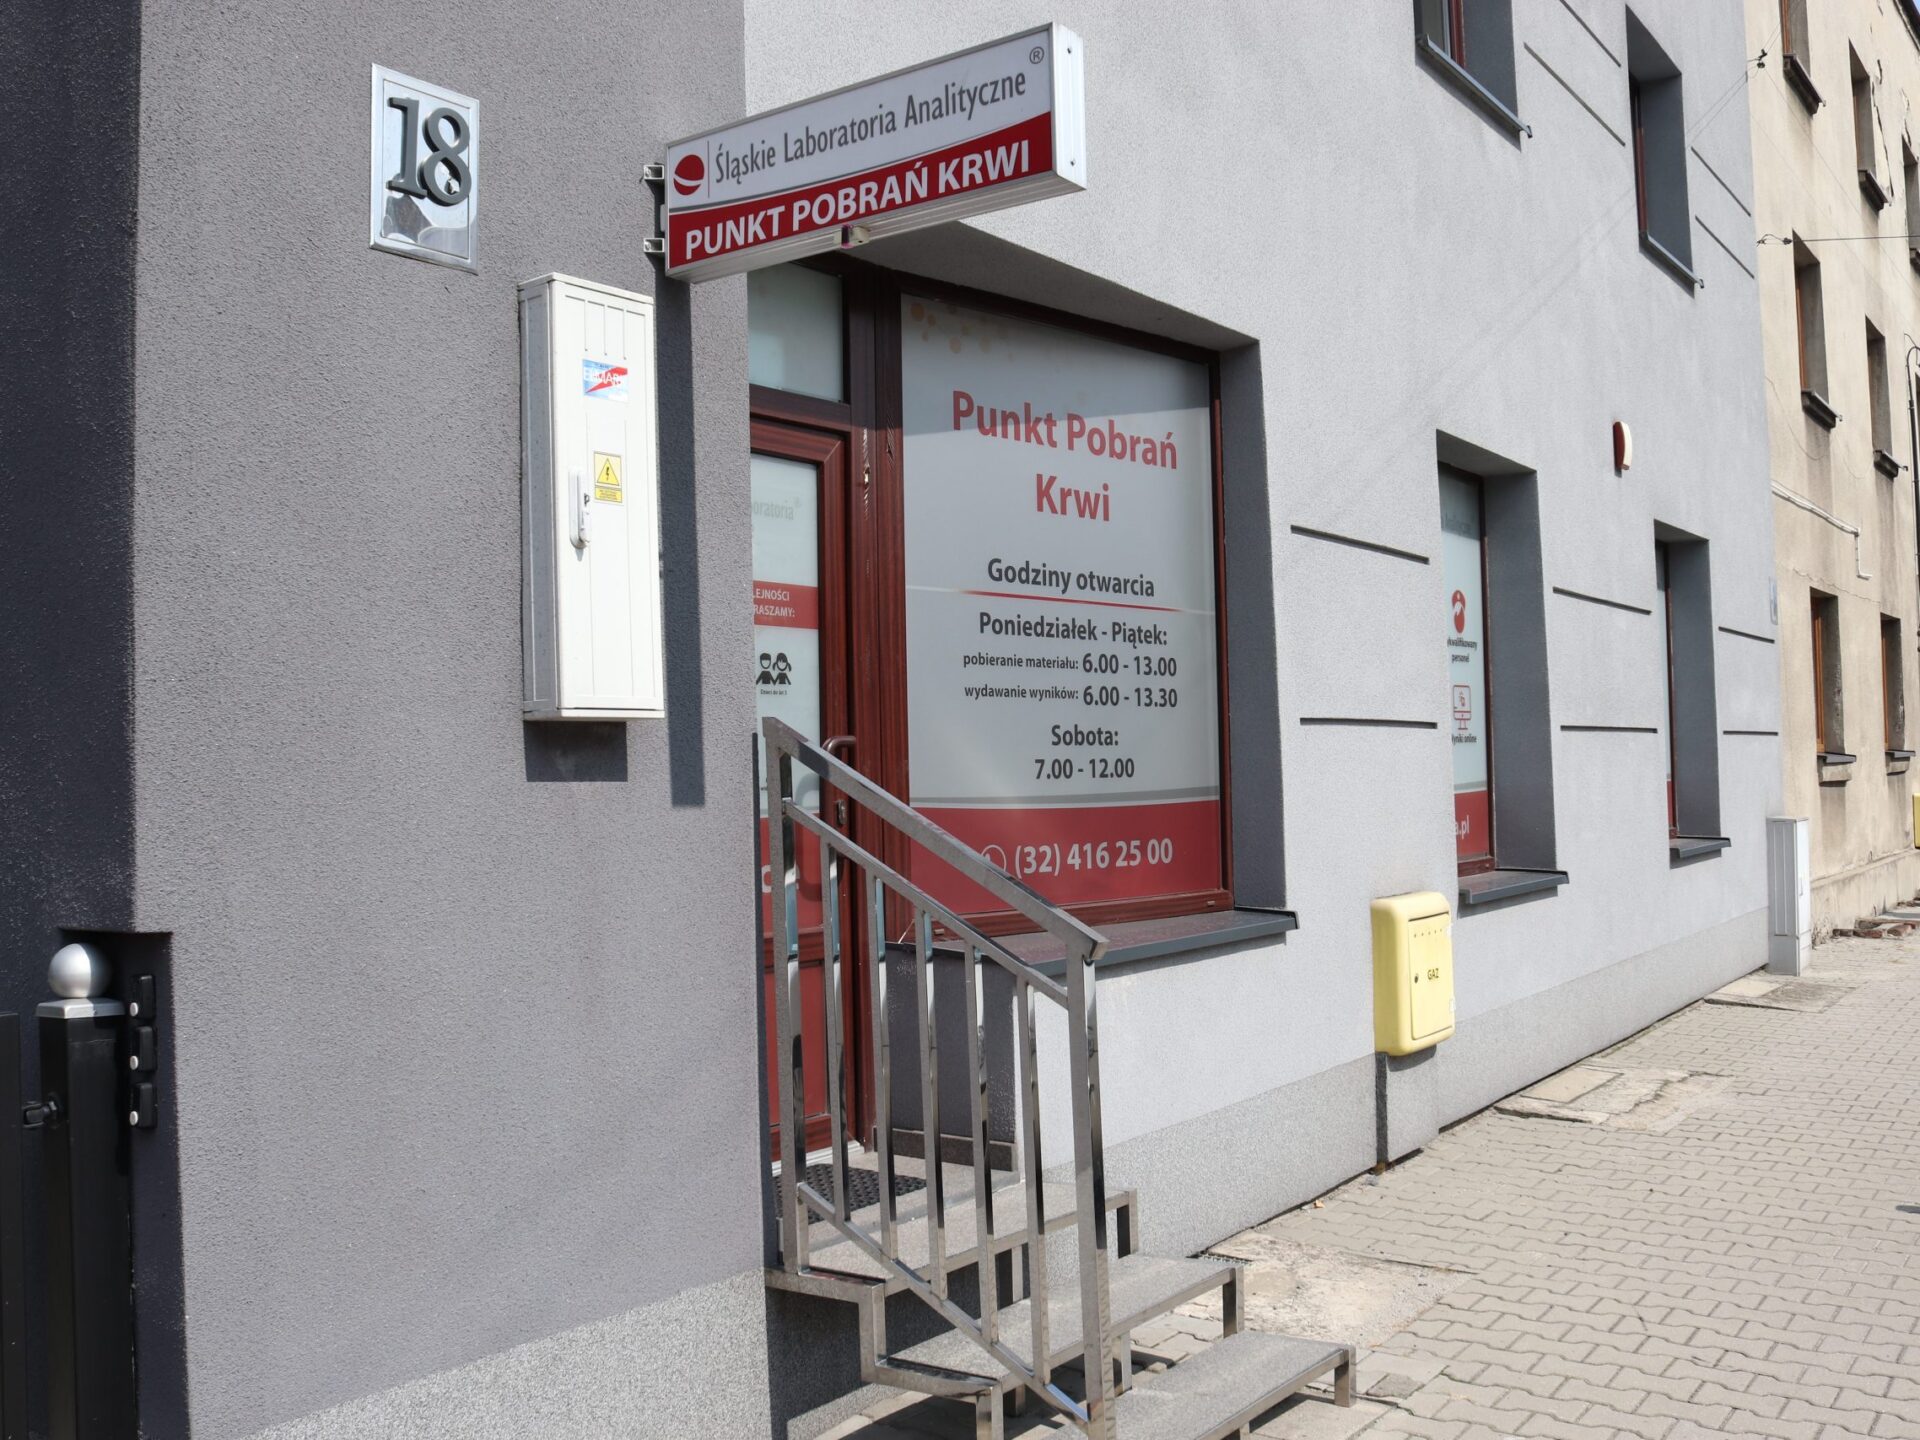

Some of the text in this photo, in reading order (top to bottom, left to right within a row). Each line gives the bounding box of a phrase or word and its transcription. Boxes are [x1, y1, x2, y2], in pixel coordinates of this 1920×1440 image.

[714, 142, 776, 185] Śląskie
[783, 103, 897, 162] Laboratoria
[904, 71, 1026, 128] Analityczne
[386, 97, 472, 207] 18
[685, 139, 1030, 260] PUNKT POBRAŃ KRWI
[952, 390, 1178, 470] Punkt Pobrań
[1035, 473, 1110, 522] Krwi
[753, 588, 790, 601] EJNOŚCI
[987, 557, 1155, 597] Godziny otwarcia
[979, 612, 1098, 641] Poniedziałek
[1112, 622, 1168, 649] Piątek:
[963, 653, 1024, 668] pobieranie
[1025, 656, 1079, 670] materiału:
[1082, 653, 1119, 675] 6.00
[1133, 656, 1178, 677] 13.00
[964, 684, 1027, 700] wydawanie
[1028, 685, 1079, 702] wyników:
[1083, 686, 1120, 707] 6.00
[1134, 688, 1178, 708] 13.30
[1051, 724, 1119, 747] Sobota:
[1035, 759, 1073, 780] 7.00
[1089, 758, 1135, 779] 12.00
[1014, 838, 1173, 879] (32) 416 25 00
[1427, 968, 1439, 980] GAZ
